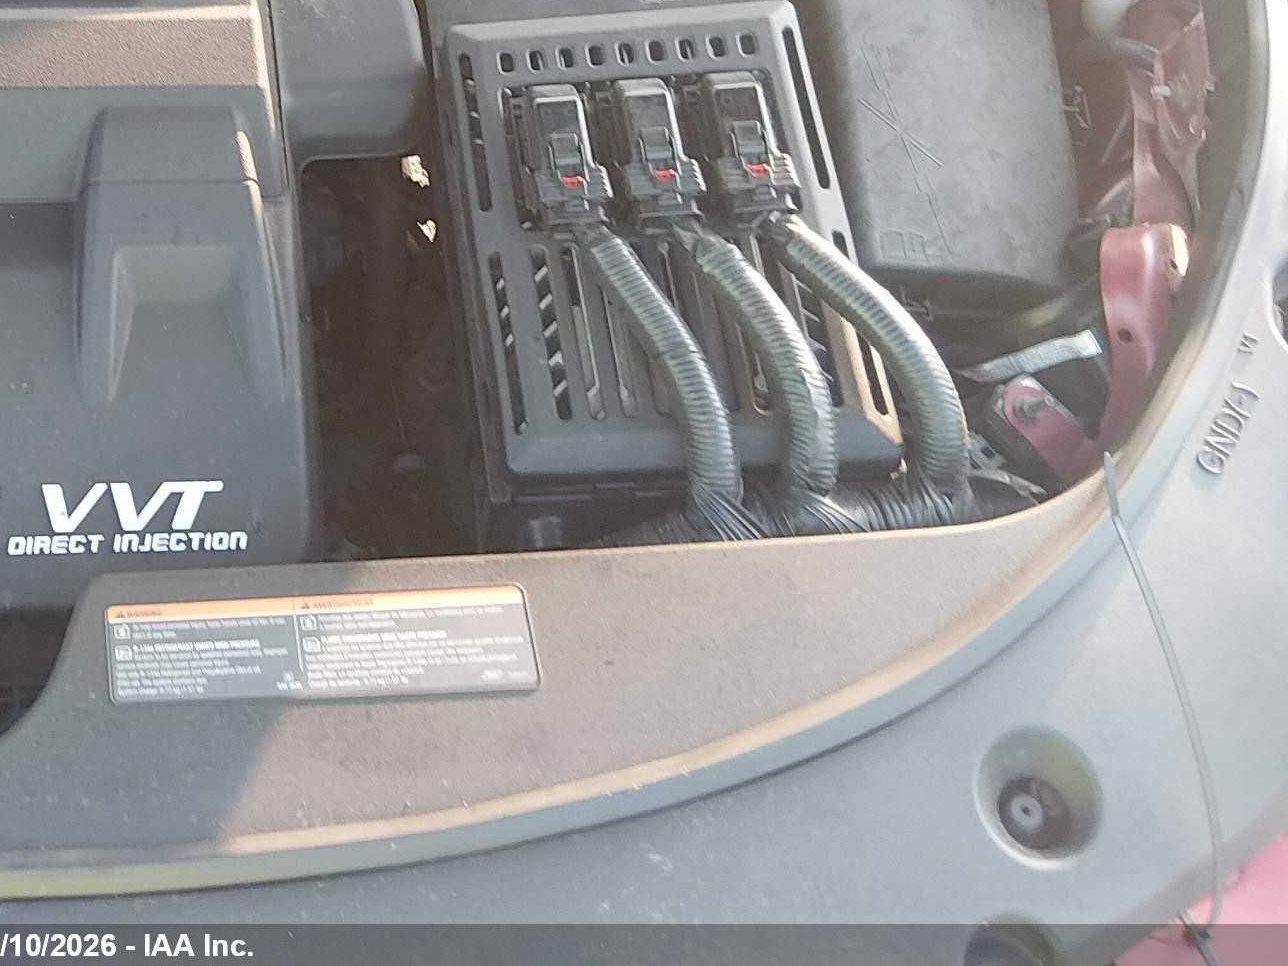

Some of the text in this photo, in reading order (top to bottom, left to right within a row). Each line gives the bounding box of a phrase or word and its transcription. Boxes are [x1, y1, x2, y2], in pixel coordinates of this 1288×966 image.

[41, 480, 225, 533] VVT
[7, 531, 248, 556] DIRECT INJECTION
